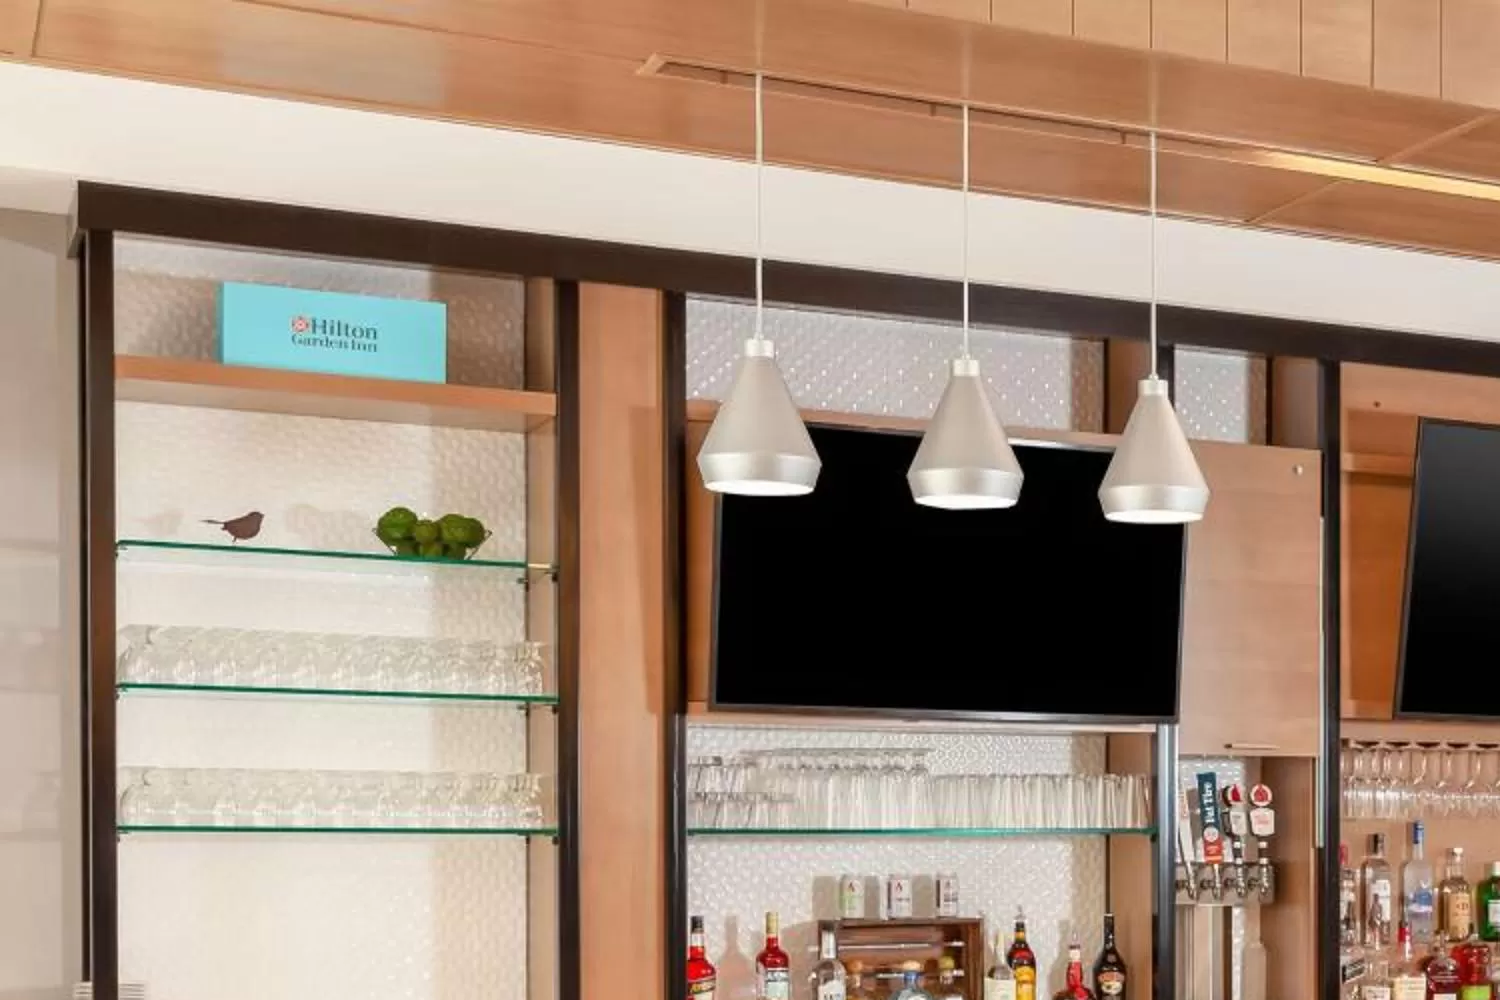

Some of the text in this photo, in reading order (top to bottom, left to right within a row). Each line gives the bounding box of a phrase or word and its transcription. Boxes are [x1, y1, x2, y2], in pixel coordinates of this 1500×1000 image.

[311, 317, 377, 340] Hilton
[291, 333, 377, 353] Garden Inn
